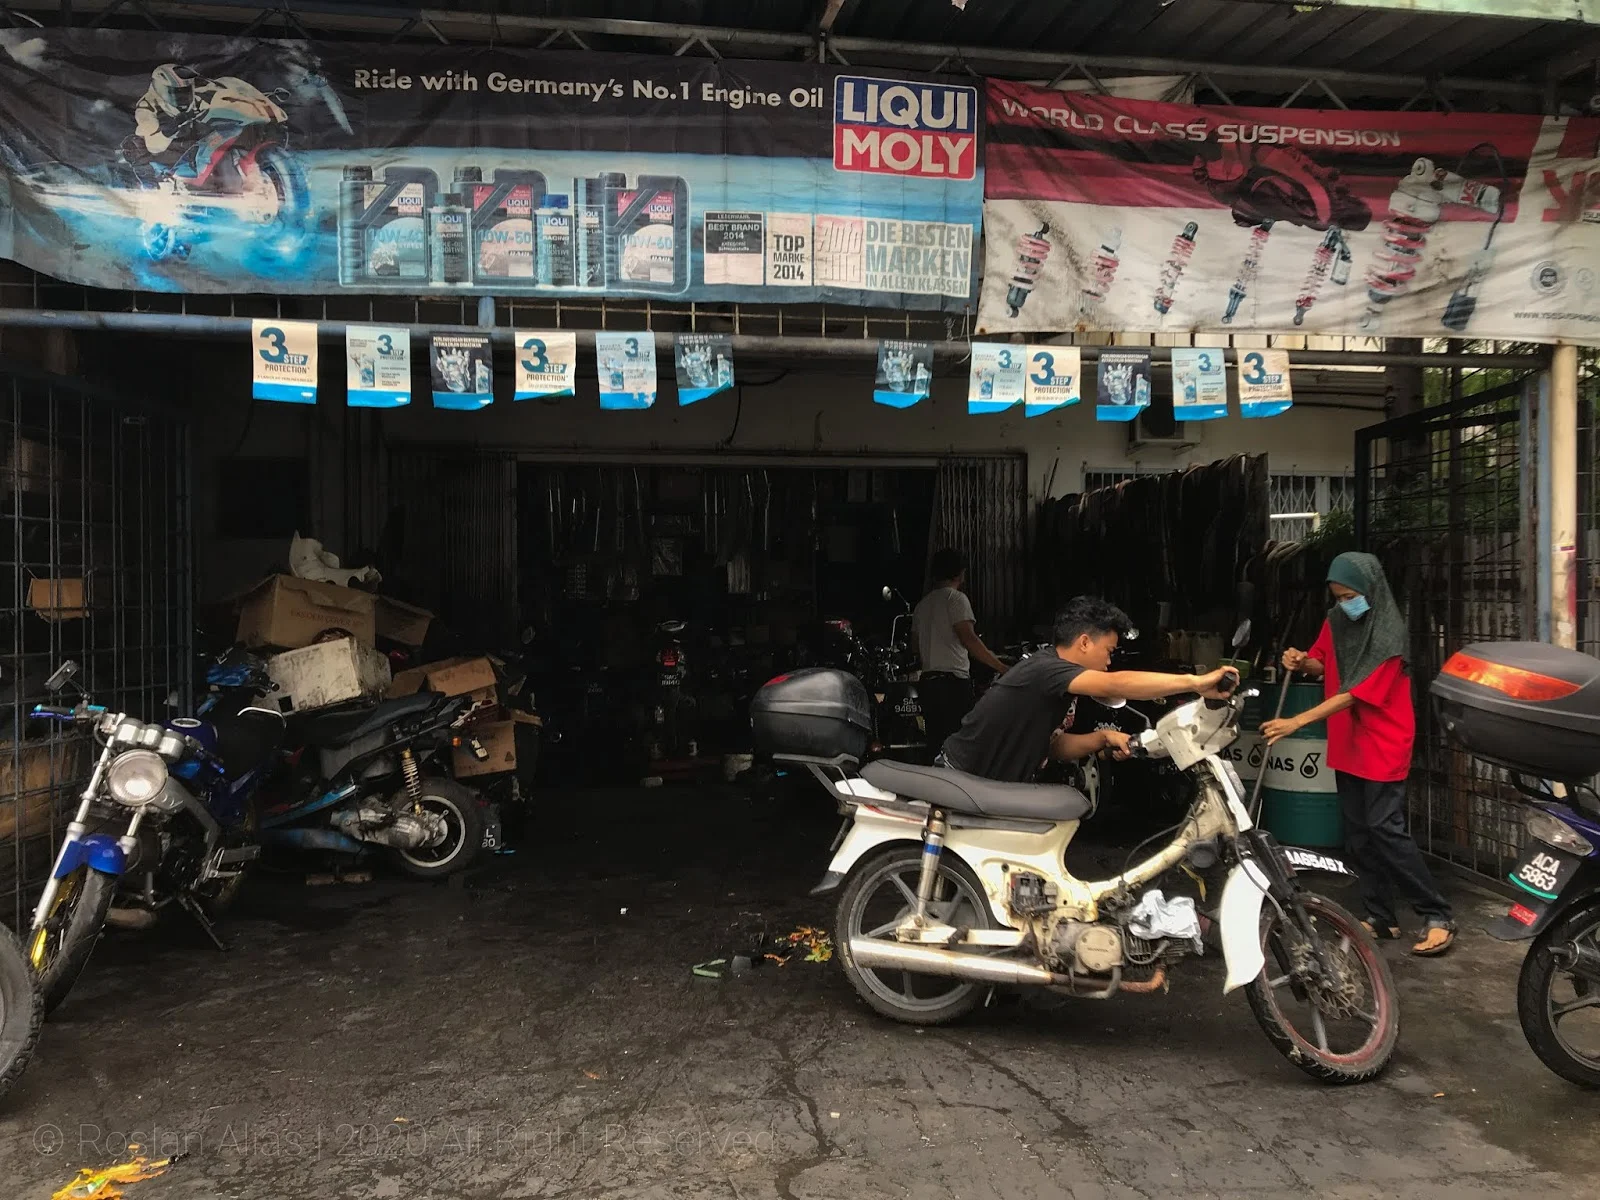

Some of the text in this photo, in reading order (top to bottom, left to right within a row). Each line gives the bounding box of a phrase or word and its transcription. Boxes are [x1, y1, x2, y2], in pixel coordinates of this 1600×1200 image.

[354, 69, 823, 110] Ride with Germany's No.1 Engine Oil
[842, 81, 968, 130] LIQUI
[1001, 98, 1401, 147] WORLD CLASS SUSPENSION
[842, 128, 972, 175] MOLY
[399, 197, 422, 205] LIQUI
[650, 204, 672, 212] LIQUI
[708, 223, 760, 231] BEST BRAND
[723, 232, 745, 240] 2014
[866, 220, 970, 249] DIE BESTEN
[477, 230, 532, 244] 10W-50
[621, 234, 673, 250] 10W-60
[773, 234, 805, 252] TOP
[773, 253, 805, 263] MARKE
[866, 244, 969, 279] MARKEN
[773, 264, 805, 280] 2014
[866, 274, 968, 295] IN ALLEN KLASSEN
[258, 326, 289, 365] 3
[376, 334, 394, 355] 3
[624, 337, 639, 358] 3
[283, 355, 306, 365] STEP
[521, 338, 549, 373] 3
[998, 349, 1012, 368] 3
[1198, 353, 1213, 372] 3
[264, 363, 307, 374] PROTECTION
[543, 363, 564, 373] STEP
[1029, 351, 1056, 386] 3
[1243, 351, 1267, 384] 3
[526, 373, 566, 382] PROTECTION
[1050, 376, 1069, 386] STEP
[1262, 374, 1281, 384] STEP
[1033, 386, 1070, 394] PROTECTION
[1531, 852, 1560, 876] ACA
[1518, 864, 1557, 891] 5863
